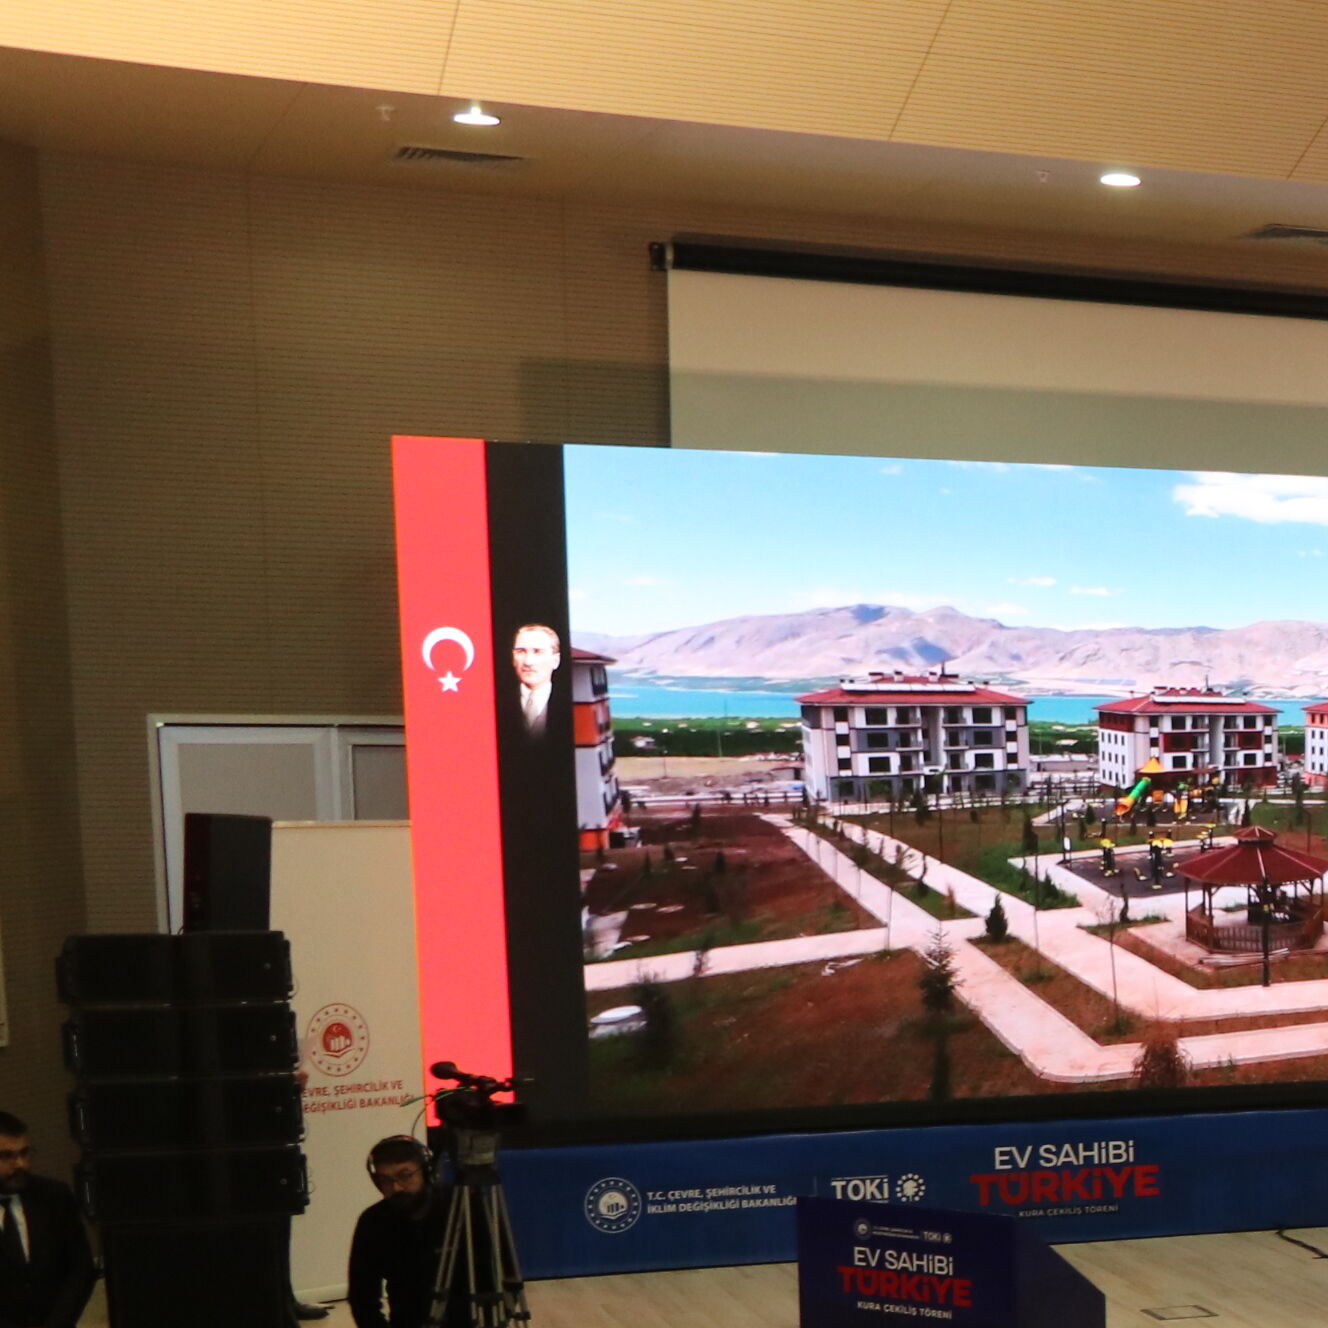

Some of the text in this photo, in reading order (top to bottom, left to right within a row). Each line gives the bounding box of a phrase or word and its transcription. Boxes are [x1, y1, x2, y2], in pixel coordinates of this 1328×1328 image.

[303, 1086, 331, 1098] EVRE,
[391, 1080, 403, 1090] VE
[304, 1099, 357, 1114] EĞİŞİKLİĞİ
[995, 1146, 1032, 1170] EV
[646, 1192, 666, 1201] T.C.
[762, 1185, 776, 1194] VE
[741, 1196, 798, 1208] BAKANLIĞI
[1019, 1209, 1045, 1218] KURA
[854, 1246, 880, 1267] EV
[857, 1301, 881, 1311] KURA
